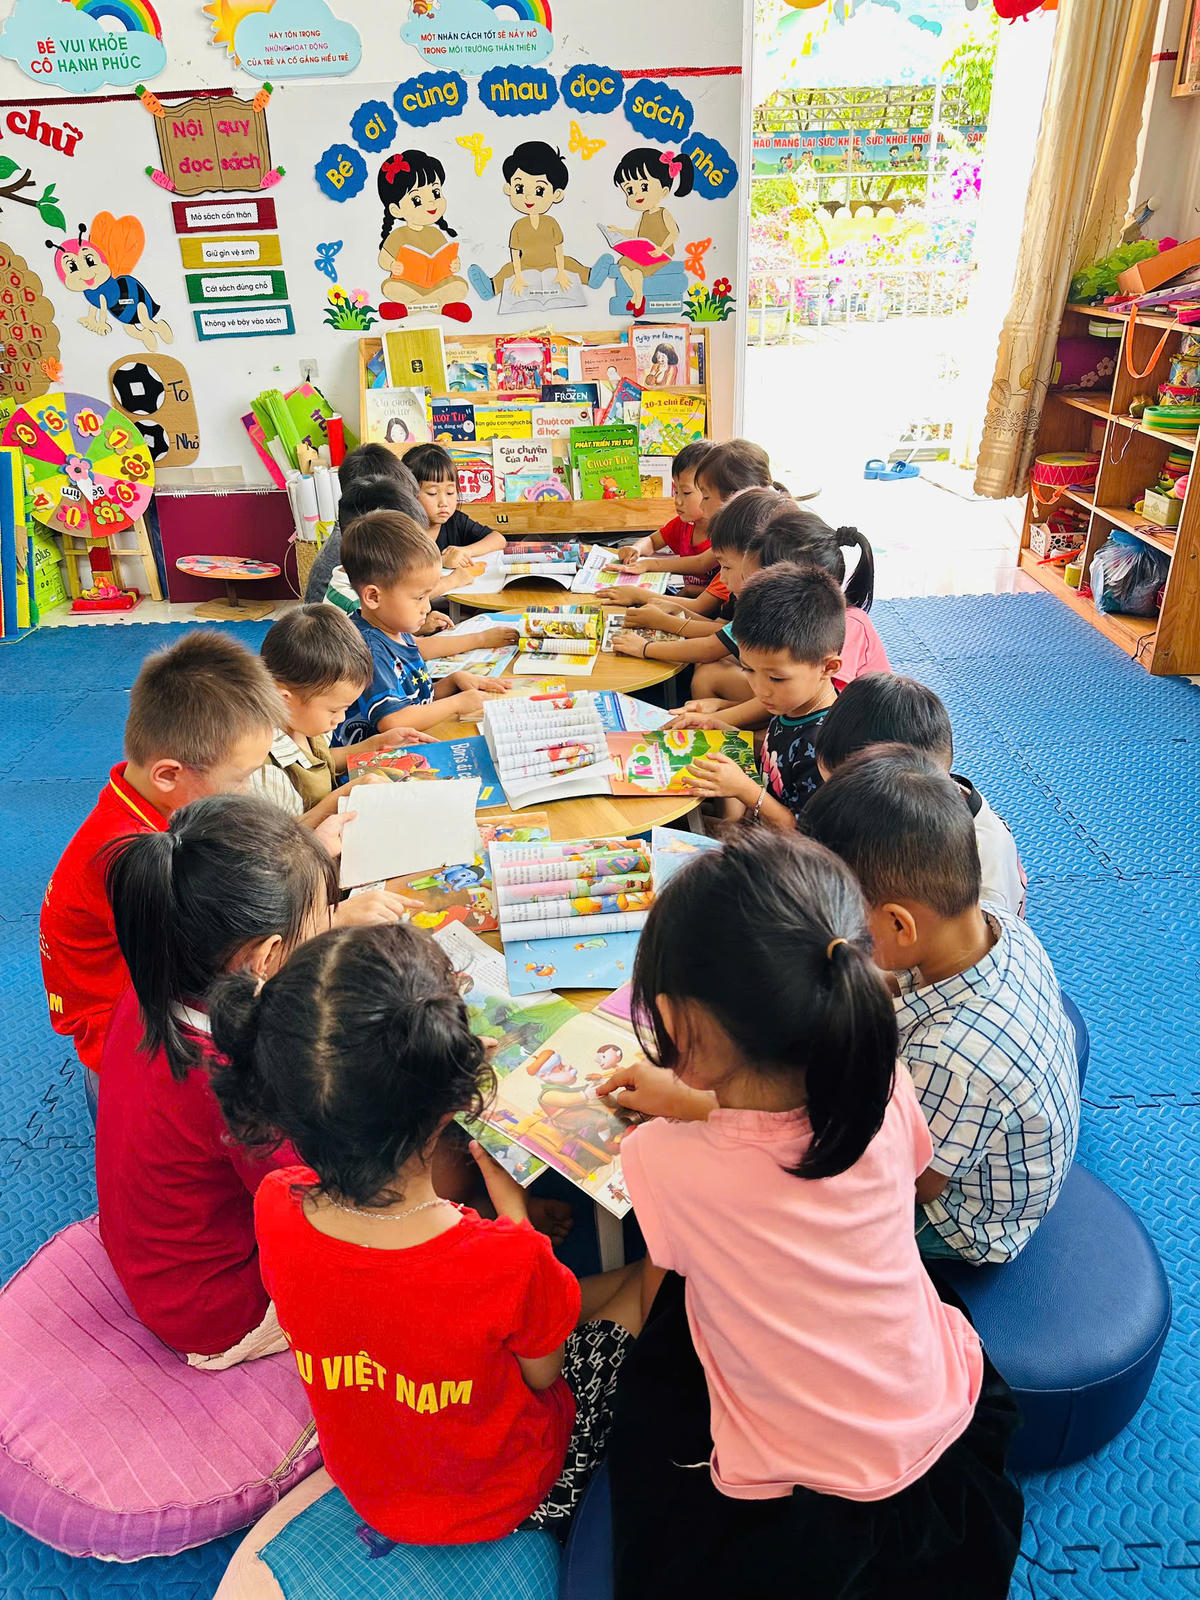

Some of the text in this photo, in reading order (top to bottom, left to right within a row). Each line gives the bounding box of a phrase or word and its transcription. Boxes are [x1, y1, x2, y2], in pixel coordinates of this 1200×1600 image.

[37, 32, 128, 54] BÉ VUI KHỎE
[423, 46, 447, 54] TRONG
[31, 53, 142, 75] CÔ HẠNH PHÚC
[402, 81, 460, 111] cùng
[490, 78, 548, 101] nhau
[570, 73, 615, 102] đọc
[632, 95, 685, 129] sách
[6, 110, 84, 157] chữ
[172, 118, 250, 141] Nội quy
[364, 112, 387, 140] ơi
[774, 138, 800, 148] MANG
[802, 137, 816, 149] LẠI
[179, 151, 261, 177] đọc sách
[325, 153, 355, 189] Bé
[689, 147, 729, 187] nhé
[203, 212, 220, 220] sách
[241, 248, 255, 256] sinh
[24, 287, 36, 302] b
[219, 283, 235, 292] sách
[12, 325, 43, 340] g h
[22, 362, 31, 373] v
[14, 381, 25, 392] u
[167, 380, 189, 402] To
[554, 391, 588, 402] FROZEN
[45, 412, 64, 430] 5
[78, 413, 100, 432] 10
[560, 417, 574, 425] con
[18, 426, 36, 443] 3
[112, 430, 128, 447] 7
[126, 461, 144, 477] 8
[321, 1350, 387, 1391] VIỆT
[396, 1373, 473, 1414] NAM
